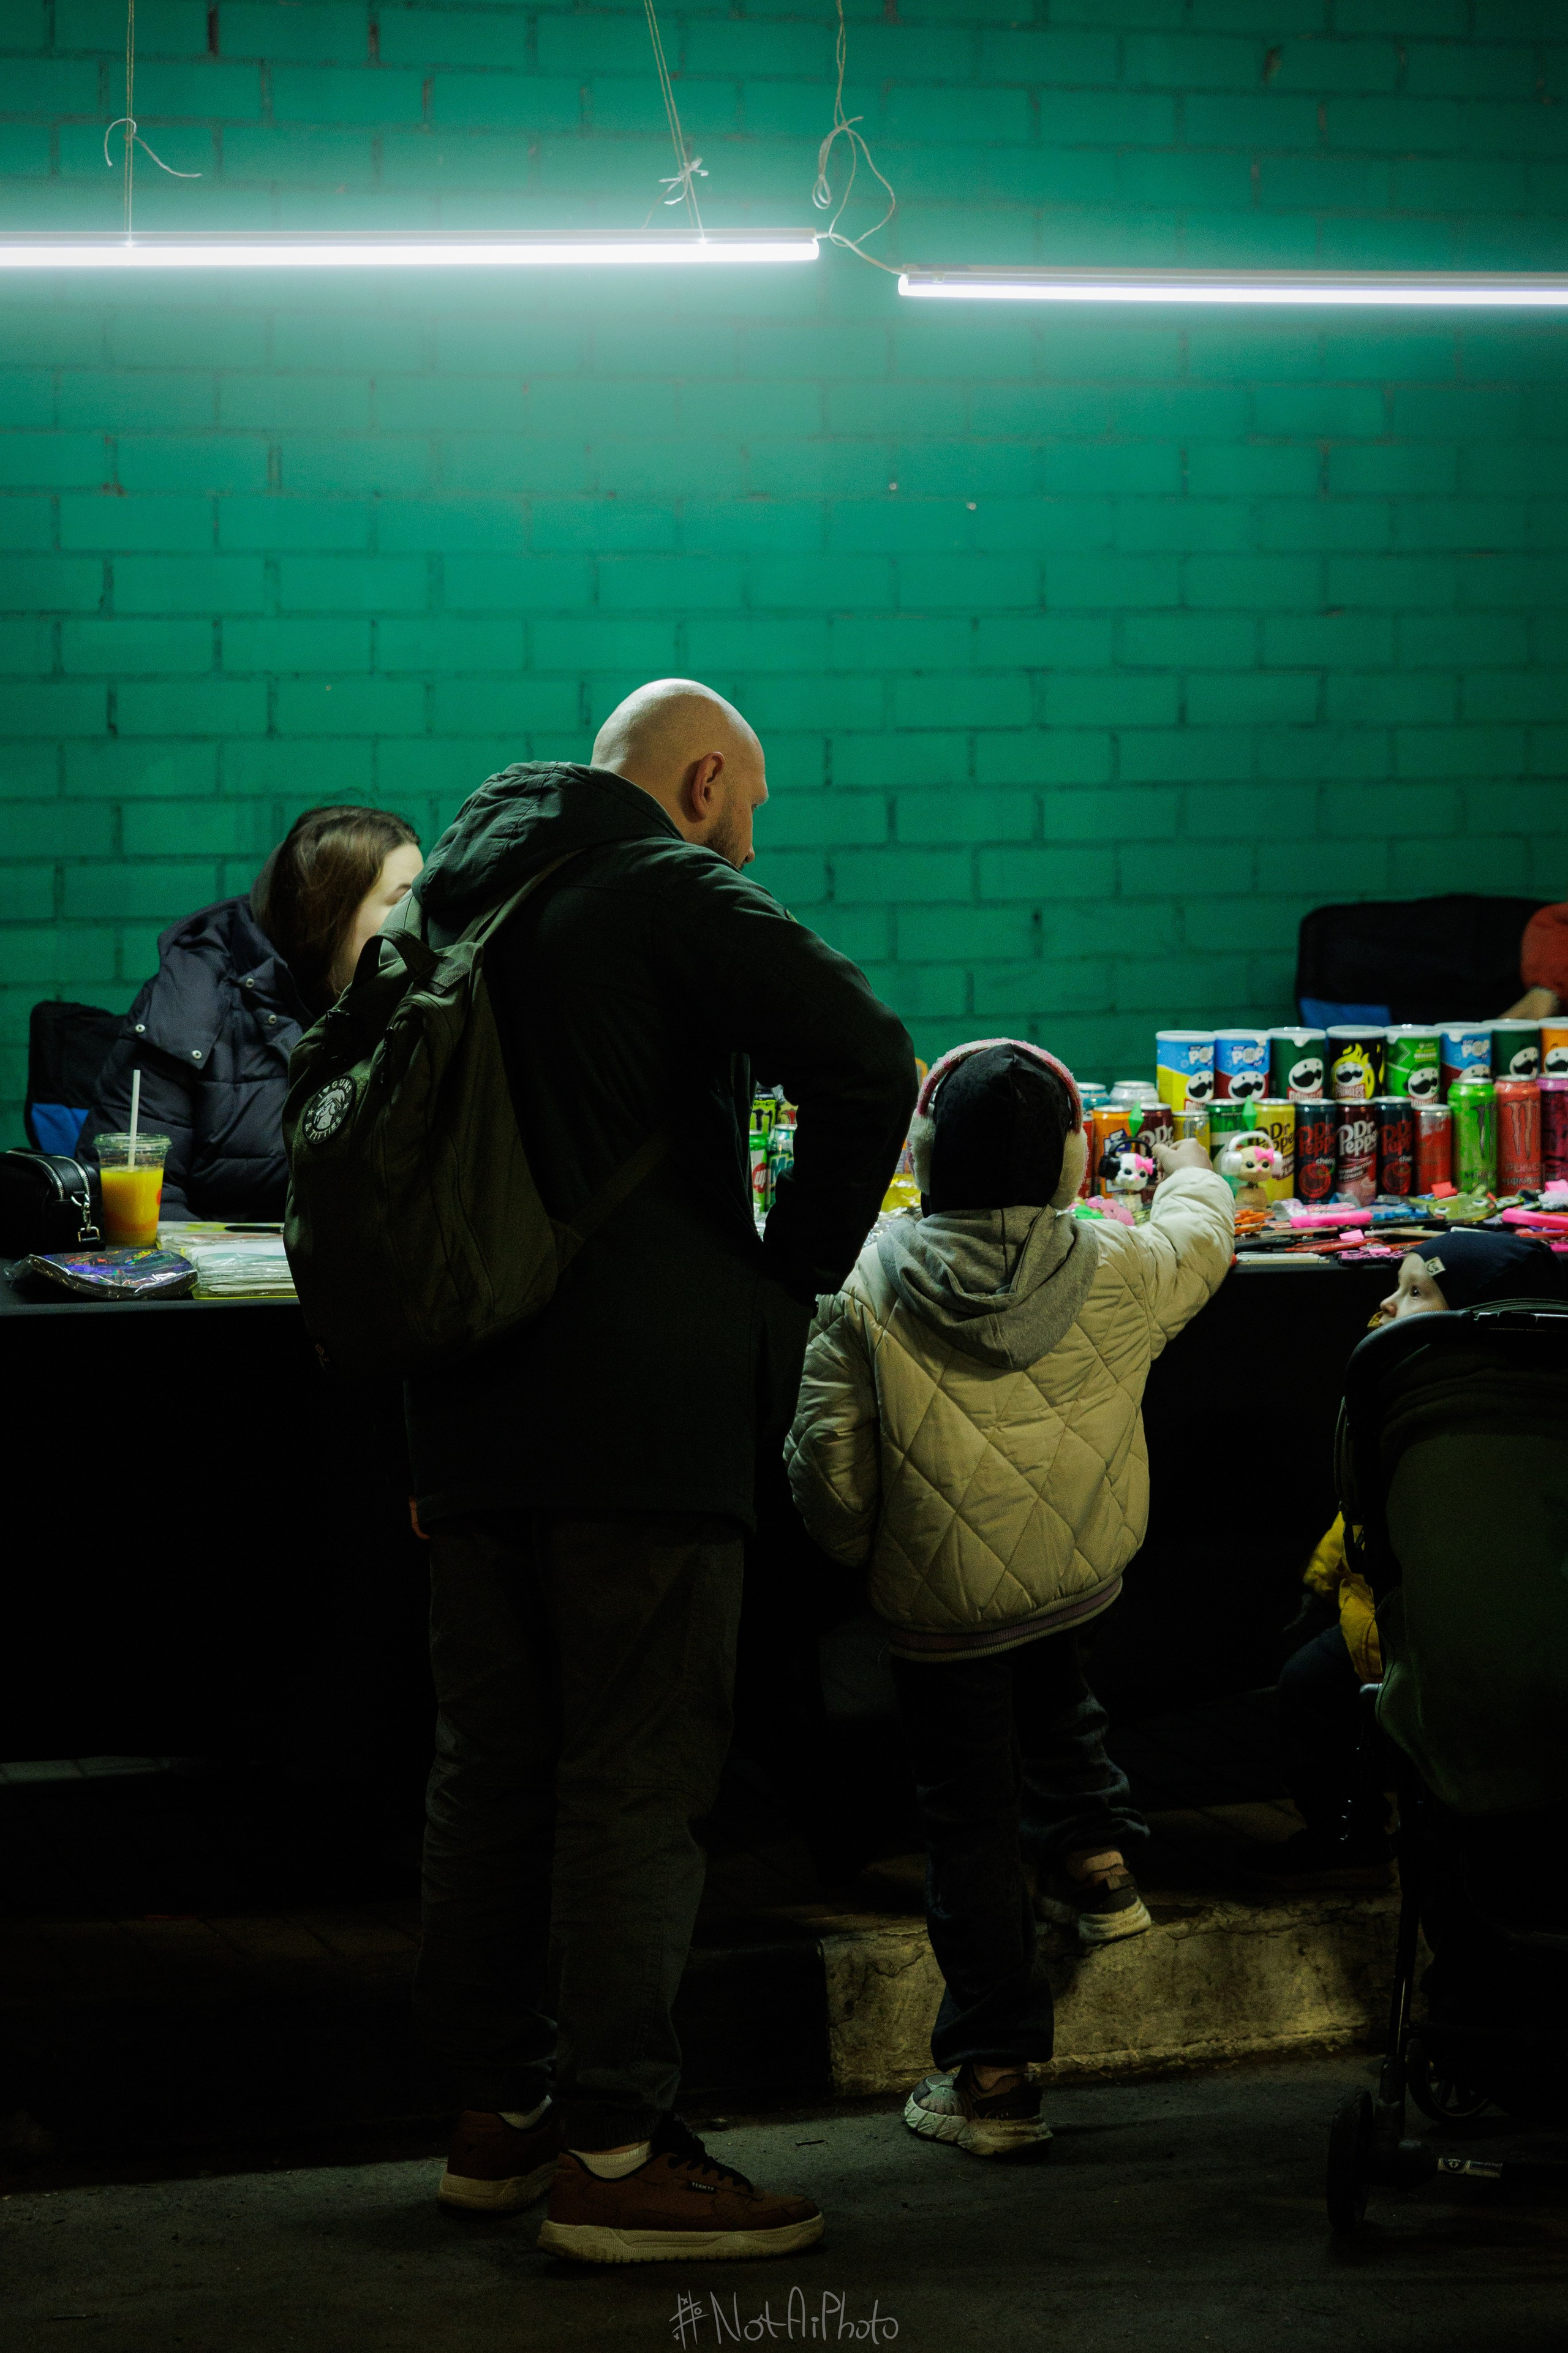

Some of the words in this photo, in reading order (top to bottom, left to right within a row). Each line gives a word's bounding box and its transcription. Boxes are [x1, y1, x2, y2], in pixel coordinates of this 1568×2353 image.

[331, 1079, 352, 1093] GUNS
[309, 1117, 341, 1139] TITTIES
[1353, 1120, 1374, 1139] Dr
[1429, 1261, 1440, 1272] FUN
